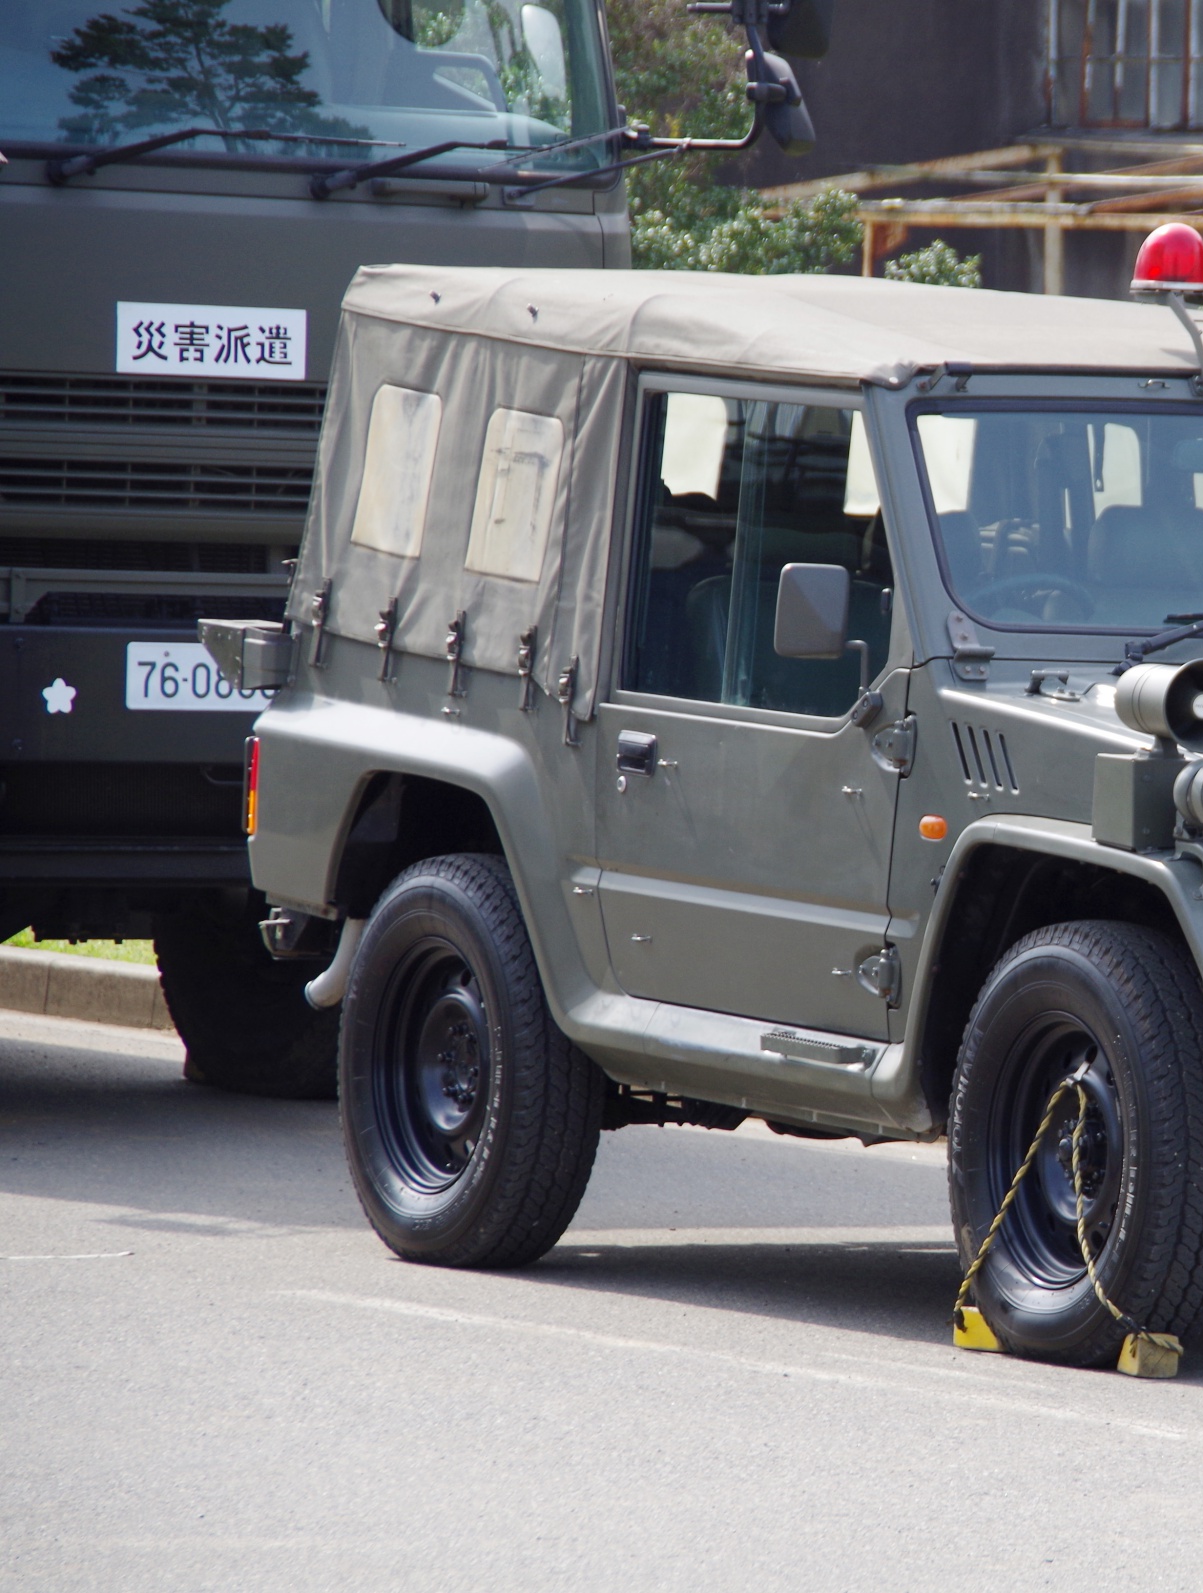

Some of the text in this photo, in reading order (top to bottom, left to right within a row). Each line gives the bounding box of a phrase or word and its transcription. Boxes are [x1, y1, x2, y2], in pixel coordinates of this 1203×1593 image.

[132, 320, 292, 365] 災害派遣
[137, 661, 281, 699] 76-08
